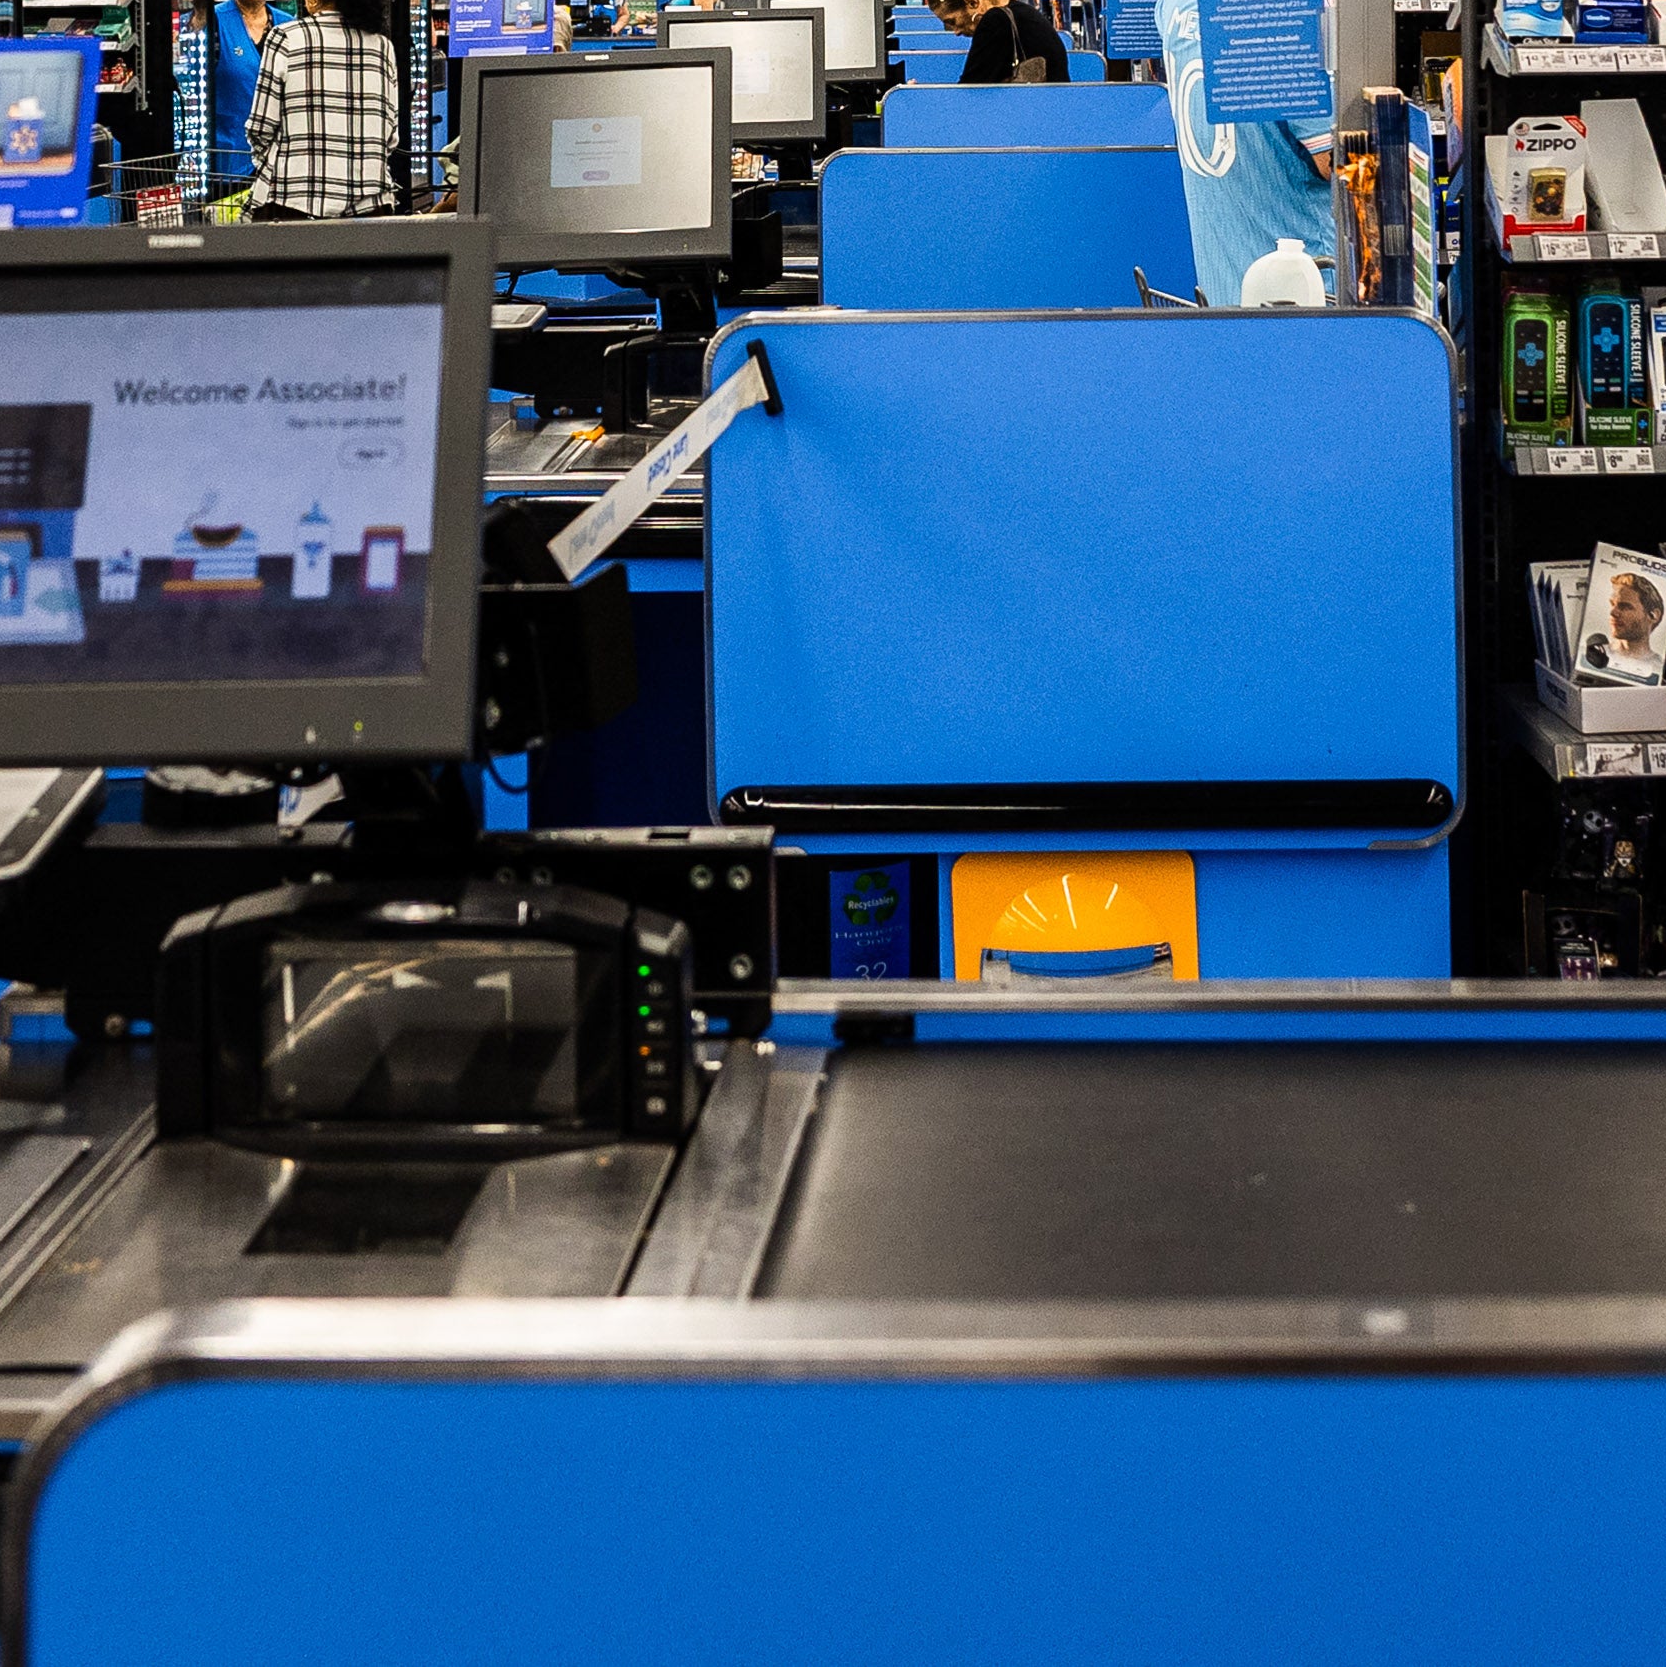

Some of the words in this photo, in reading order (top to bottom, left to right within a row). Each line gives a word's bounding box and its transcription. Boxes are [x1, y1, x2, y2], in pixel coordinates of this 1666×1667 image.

[456, 5, 463, 13] is
[464, 5, 483, 13] here
[1526, 138, 1577, 152] ZIPPO
[1555, 319, 1567, 352] SILICONE
[1630, 304, 1643, 337] SILICONE
[1554, 352, 1567, 386] SLEEVE
[1630, 338, 1643, 372] SLEEVE
[115, 377, 250, 406] Welcome
[256, 373, 406, 402] Associate!
[1588, 416, 1612, 425] SILICONE
[1612, 416, 1633, 425] SLEEVE
[847, 895, 894, 910] Recyclables
